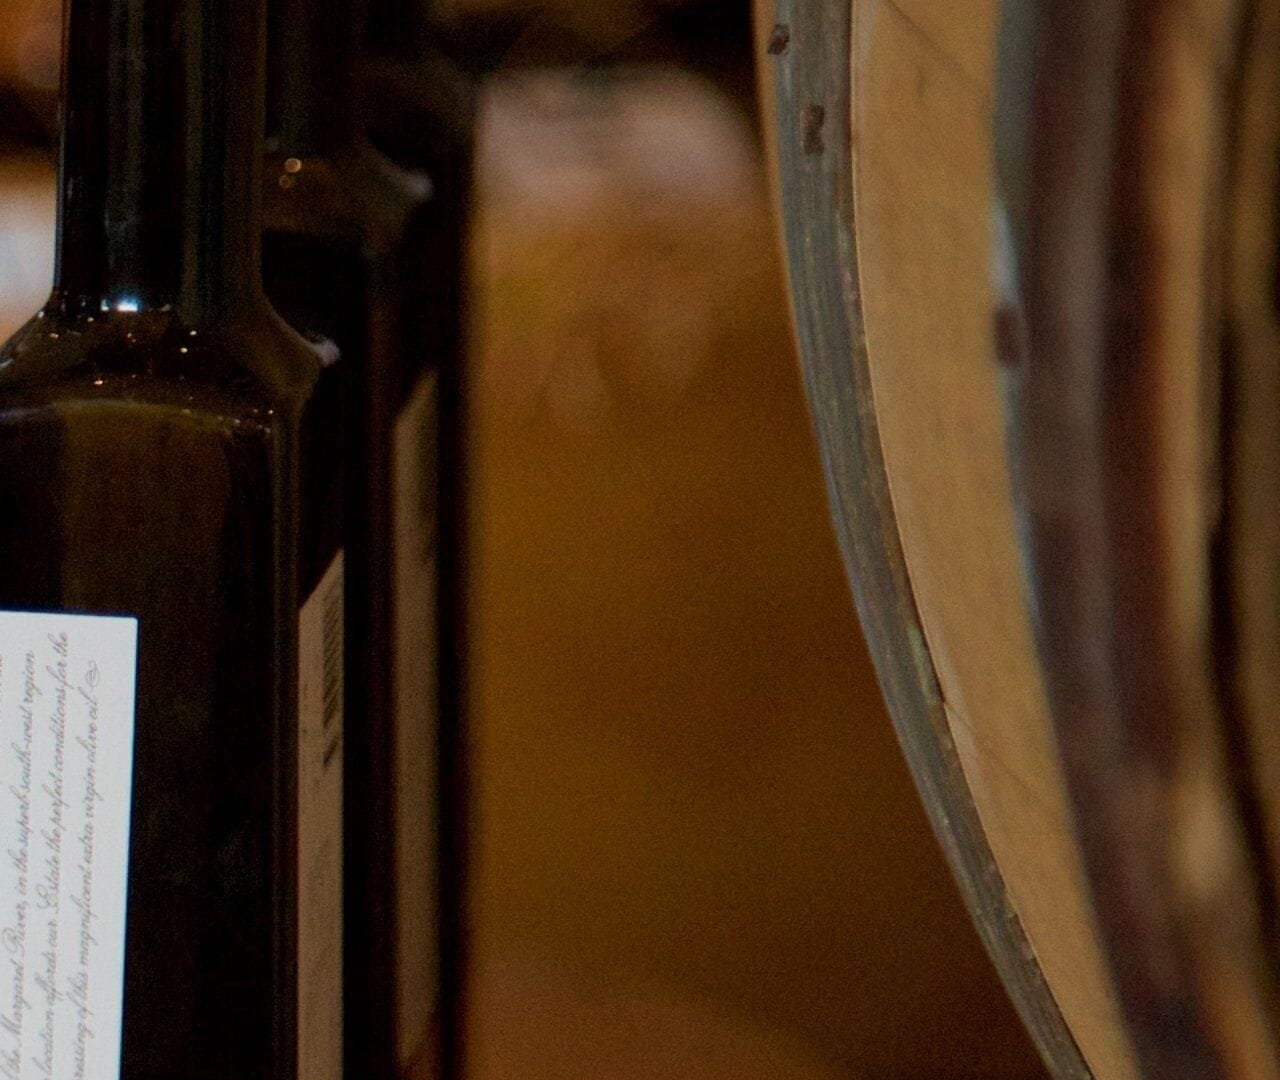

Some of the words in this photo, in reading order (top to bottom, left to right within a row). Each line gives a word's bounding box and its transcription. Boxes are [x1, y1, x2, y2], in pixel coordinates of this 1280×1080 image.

[46, 631, 68, 658] the
[21, 651, 42, 704] region
[45, 659, 74, 689] for
[10, 704, 32, 793] south-west
[47, 688, 67, 773] conditions
[74, 722, 97, 763] olive
[8, 784, 34, 848] superb
[41, 771, 70, 831] perfect
[82, 766, 103, 818] virgin
[7, 848, 27, 874] the
[40, 828, 60, 854] the
[77, 823, 93, 865] extra
[13, 877, 27, 896] in
[35, 856, 60, 914] Estate
[1, 901, 30, 958] River,
[47, 920, 58, 948] our
[69, 864, 98, 967] magnificent
[0, 958, 31, 1048] Margaret
[33, 951, 64, 1007] affords
[66, 972, 88, 1001] this
[65, 991, 94, 1021] of
[0, 1049, 21, 1074] the
[31, 1010, 53, 1075] location
